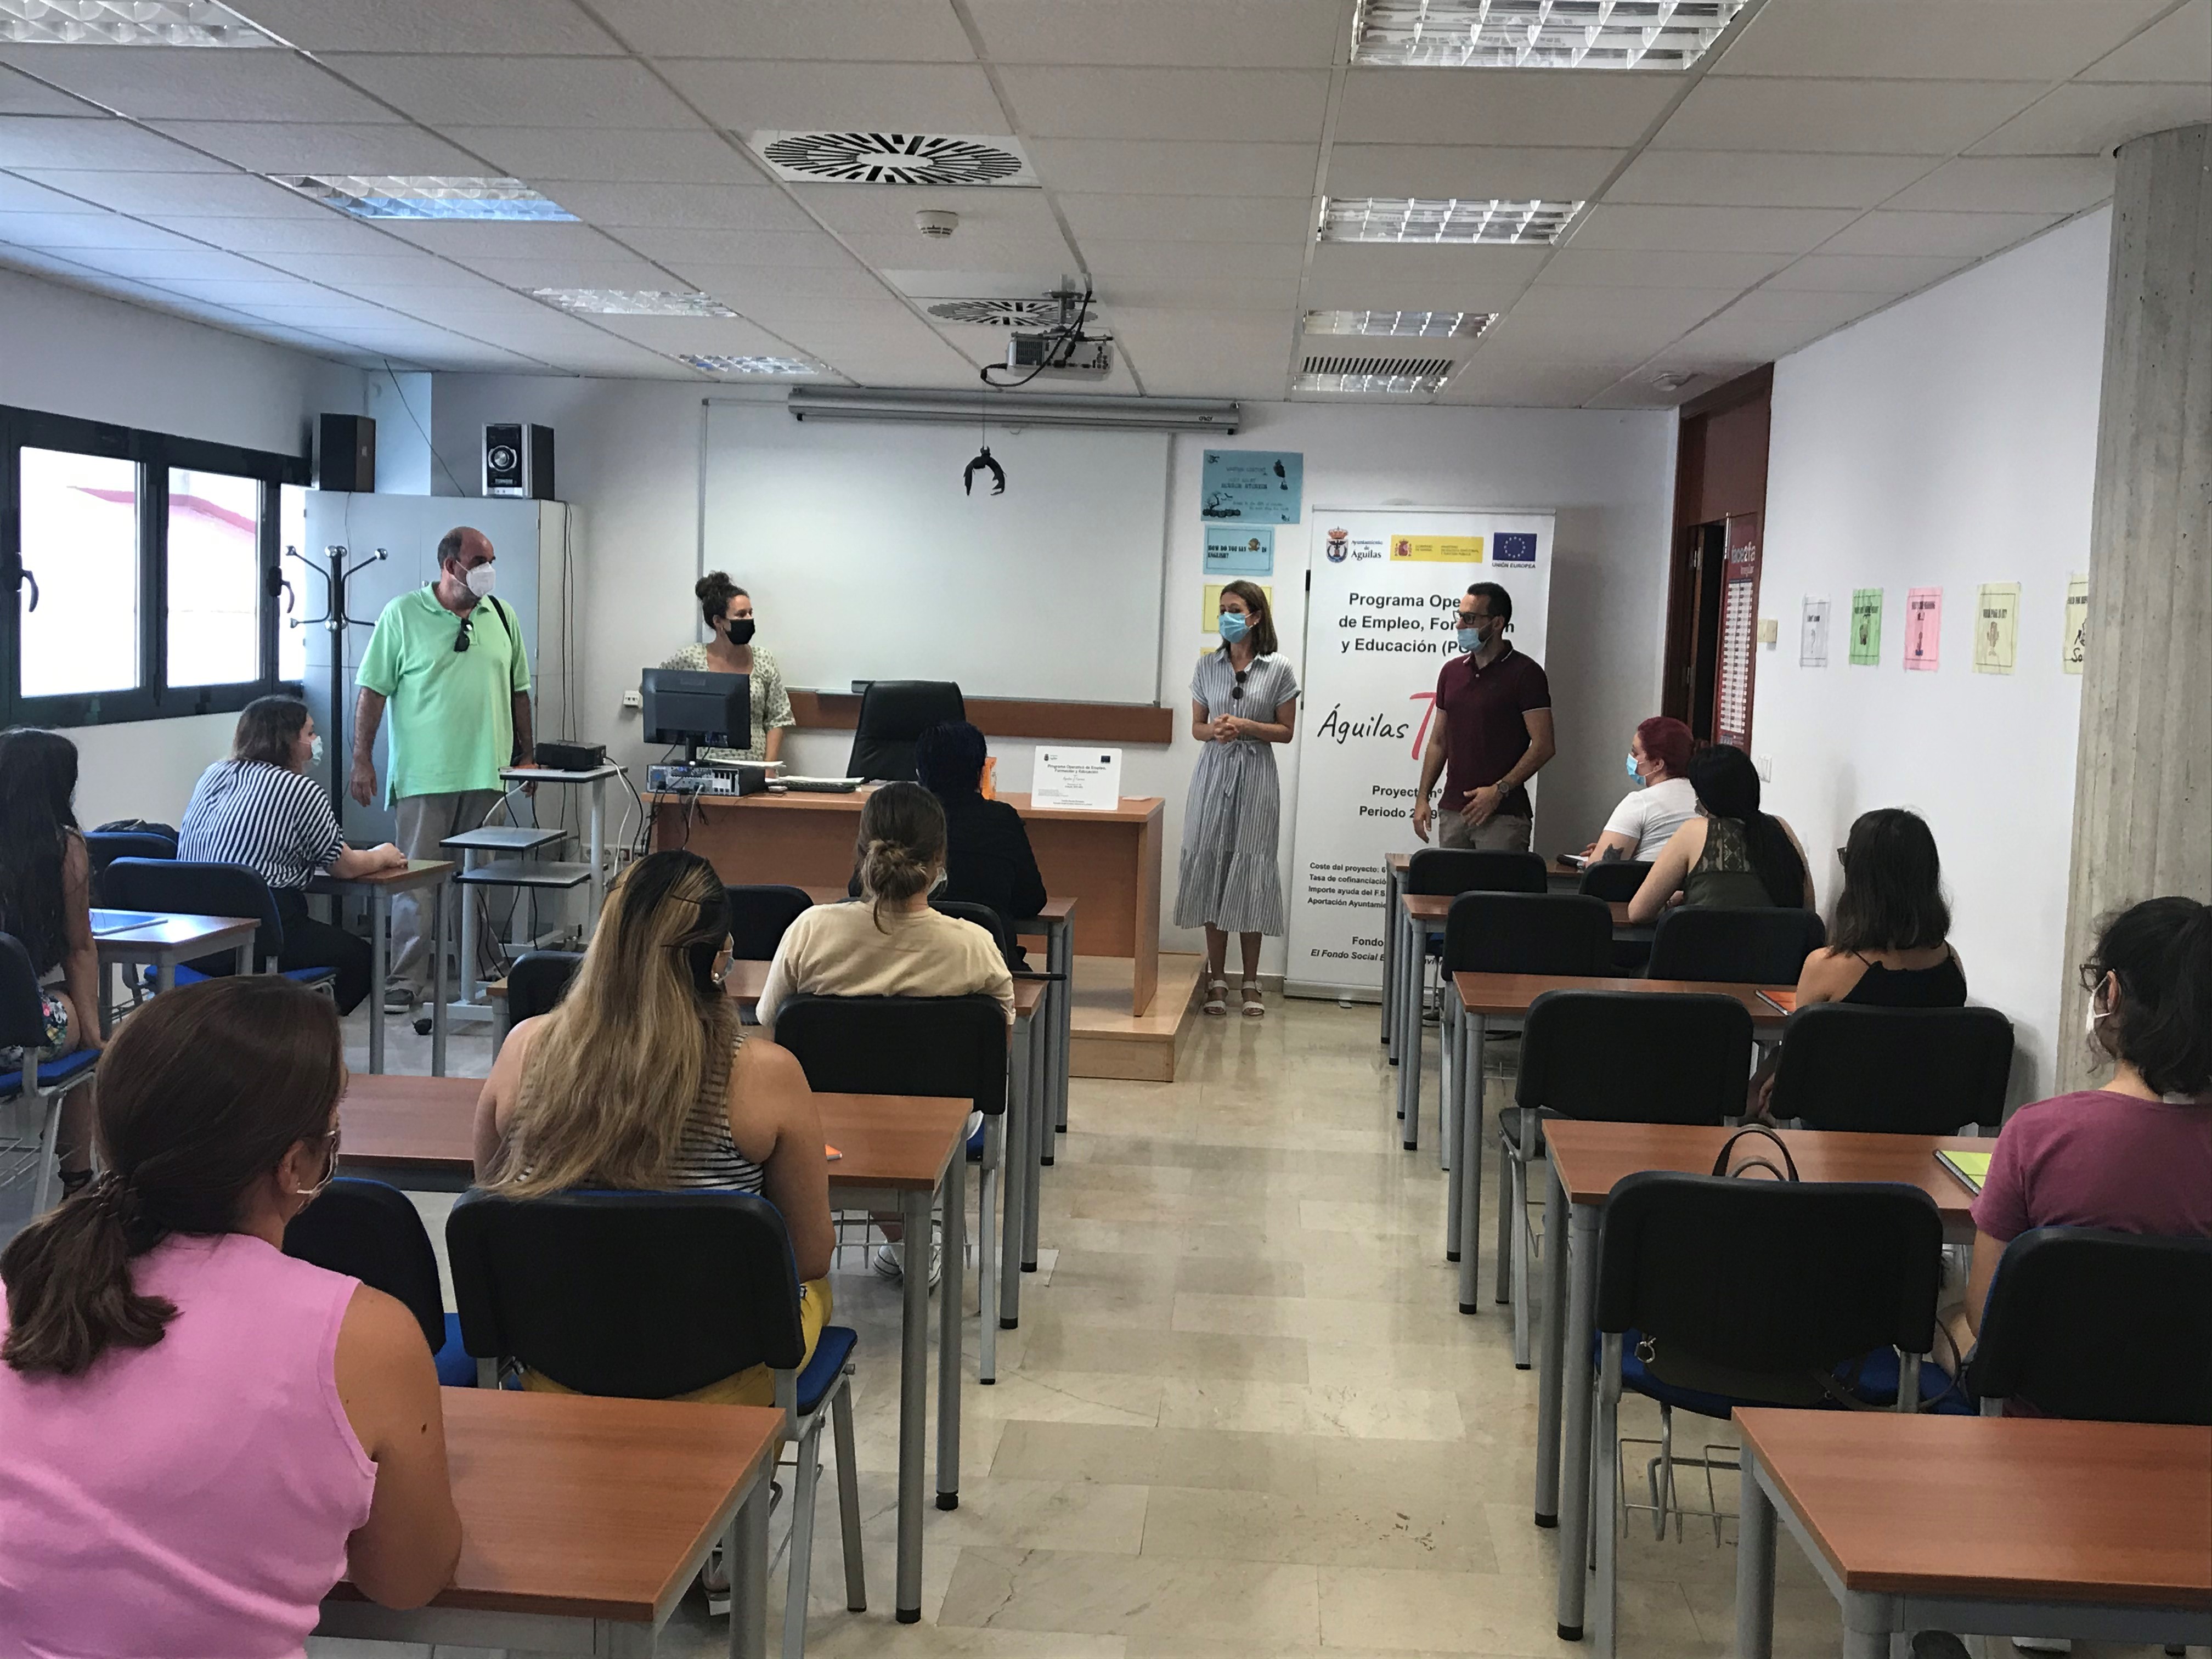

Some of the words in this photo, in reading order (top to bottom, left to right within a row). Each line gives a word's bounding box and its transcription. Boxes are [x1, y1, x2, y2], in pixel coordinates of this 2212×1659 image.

[1349, 592, 1424, 608] Programa
[1339, 616, 1357, 628] de
[1362, 616, 1424, 631] Empleo,
[1341, 642, 1350, 653] y
[1355, 638, 1437, 653] Educación
[1317, 703, 1409, 744] Águilas
[1372, 785, 1419, 799] Proyect
[1359, 806, 1406, 818] Periodo
[1345, 865, 1379, 873] proyecto:
[1338, 876, 1386, 885] cofinanciació
[1308, 885, 1336, 894] Importe
[1307, 897, 1347, 906] Aportación
[1352, 936, 1384, 947] Fondo
[1311, 949, 1319, 957] El
[1322, 950, 1349, 959] Fondo
[1351, 951, 1378, 961] Social
